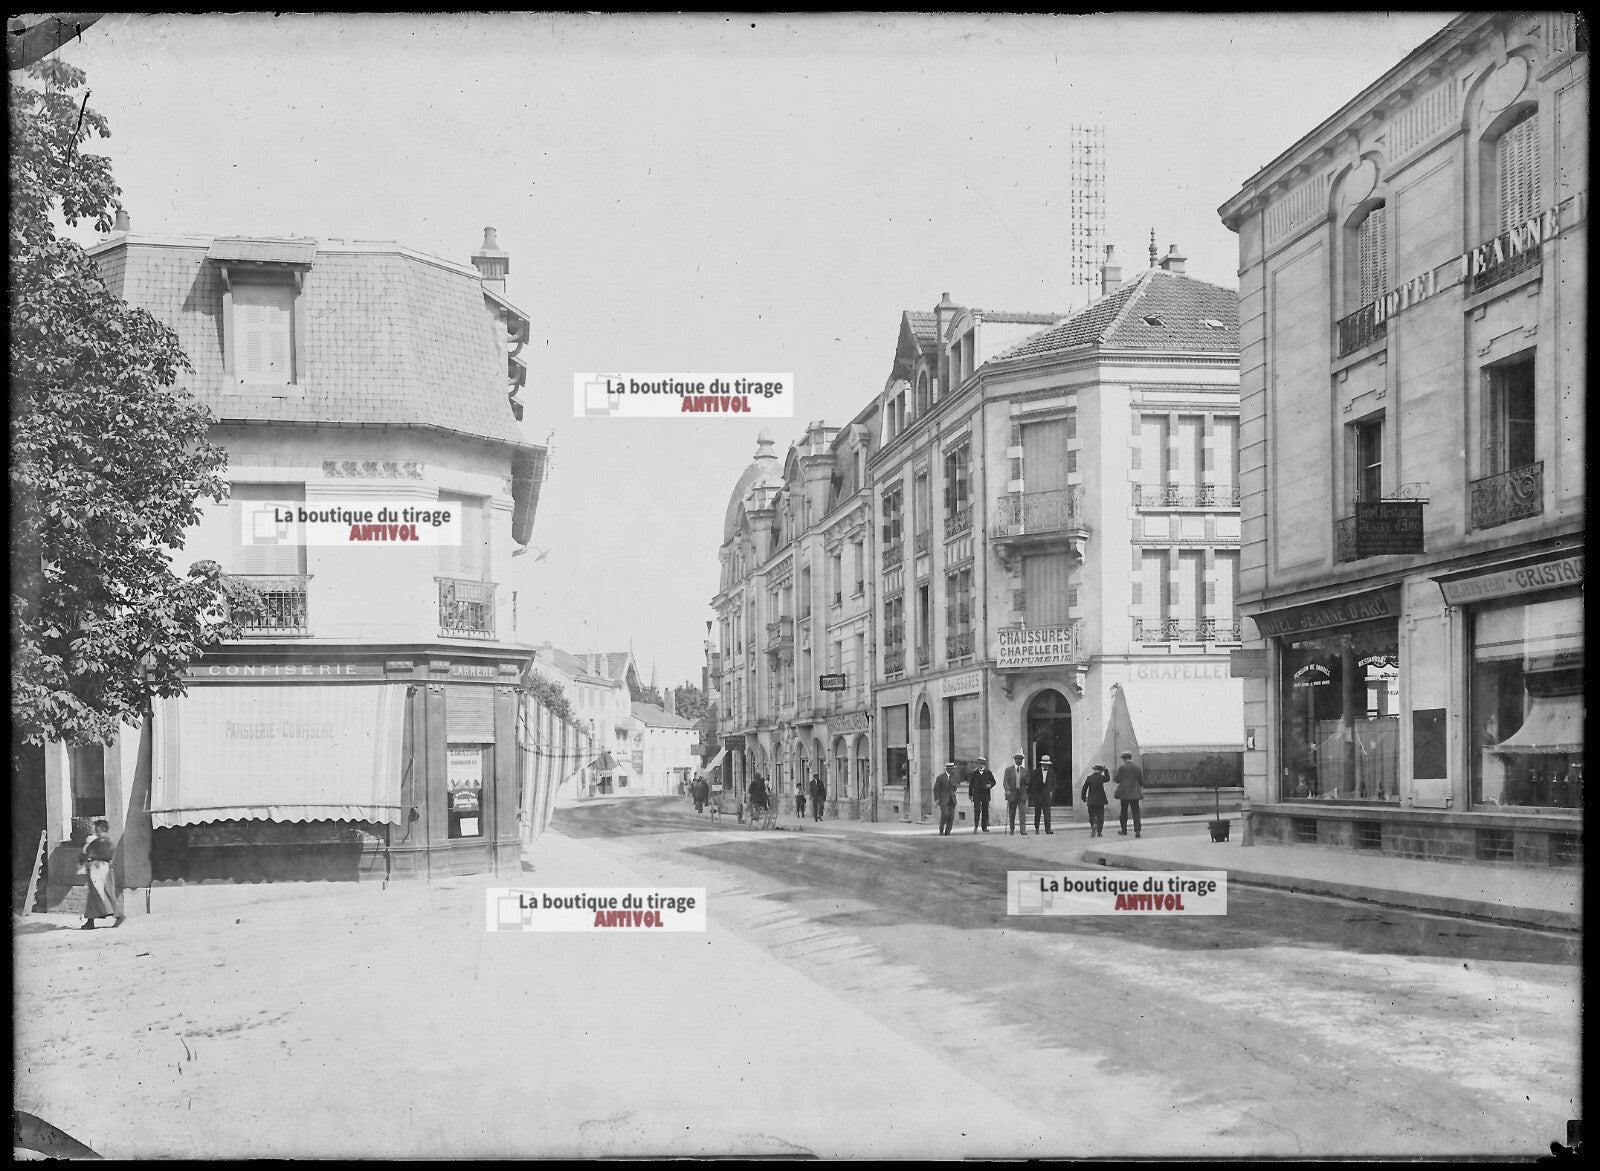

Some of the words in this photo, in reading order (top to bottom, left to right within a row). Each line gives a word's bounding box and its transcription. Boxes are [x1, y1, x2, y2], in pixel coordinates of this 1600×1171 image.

[1374, 270, 1440, 325] HOTEL
[1455, 205, 1559, 283] JEANNE
[1300, 606, 1347, 628] JEANNE
[1350, 597, 1386, 619] D'ARC
[999, 629, 1071, 645] CHAUSSURES
[1000, 644, 1070, 657] CHAPELLERIE
[999, 655, 1071, 665] PARFUMERIE
[208, 664, 358, 676] CONFISERIE
